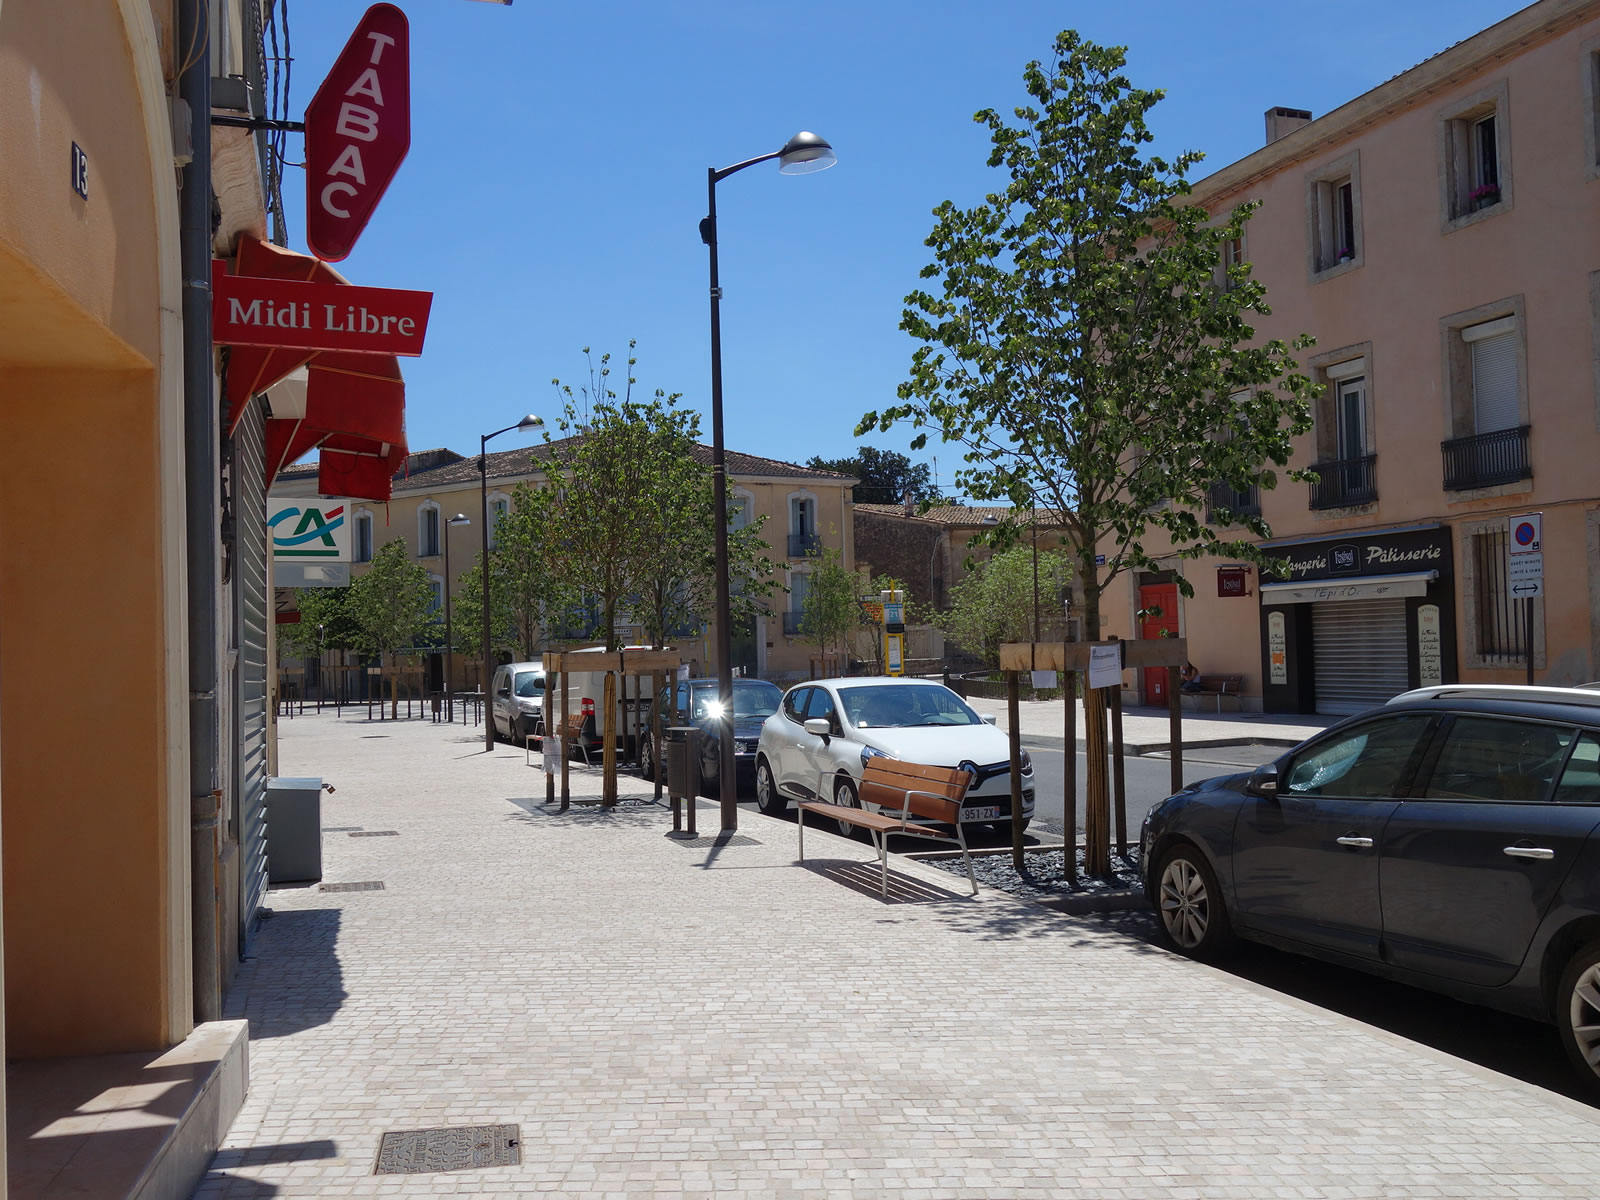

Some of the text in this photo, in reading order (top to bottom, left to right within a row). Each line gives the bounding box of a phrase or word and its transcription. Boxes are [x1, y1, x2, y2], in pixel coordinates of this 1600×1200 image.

[320, 31, 396, 219] TABAC
[75, 146, 89, 196] 13
[227, 296, 416, 337] Midi Libre
[1364, 543, 1441, 565] Pâtisserie
[889, 610, 898, 618] 21
